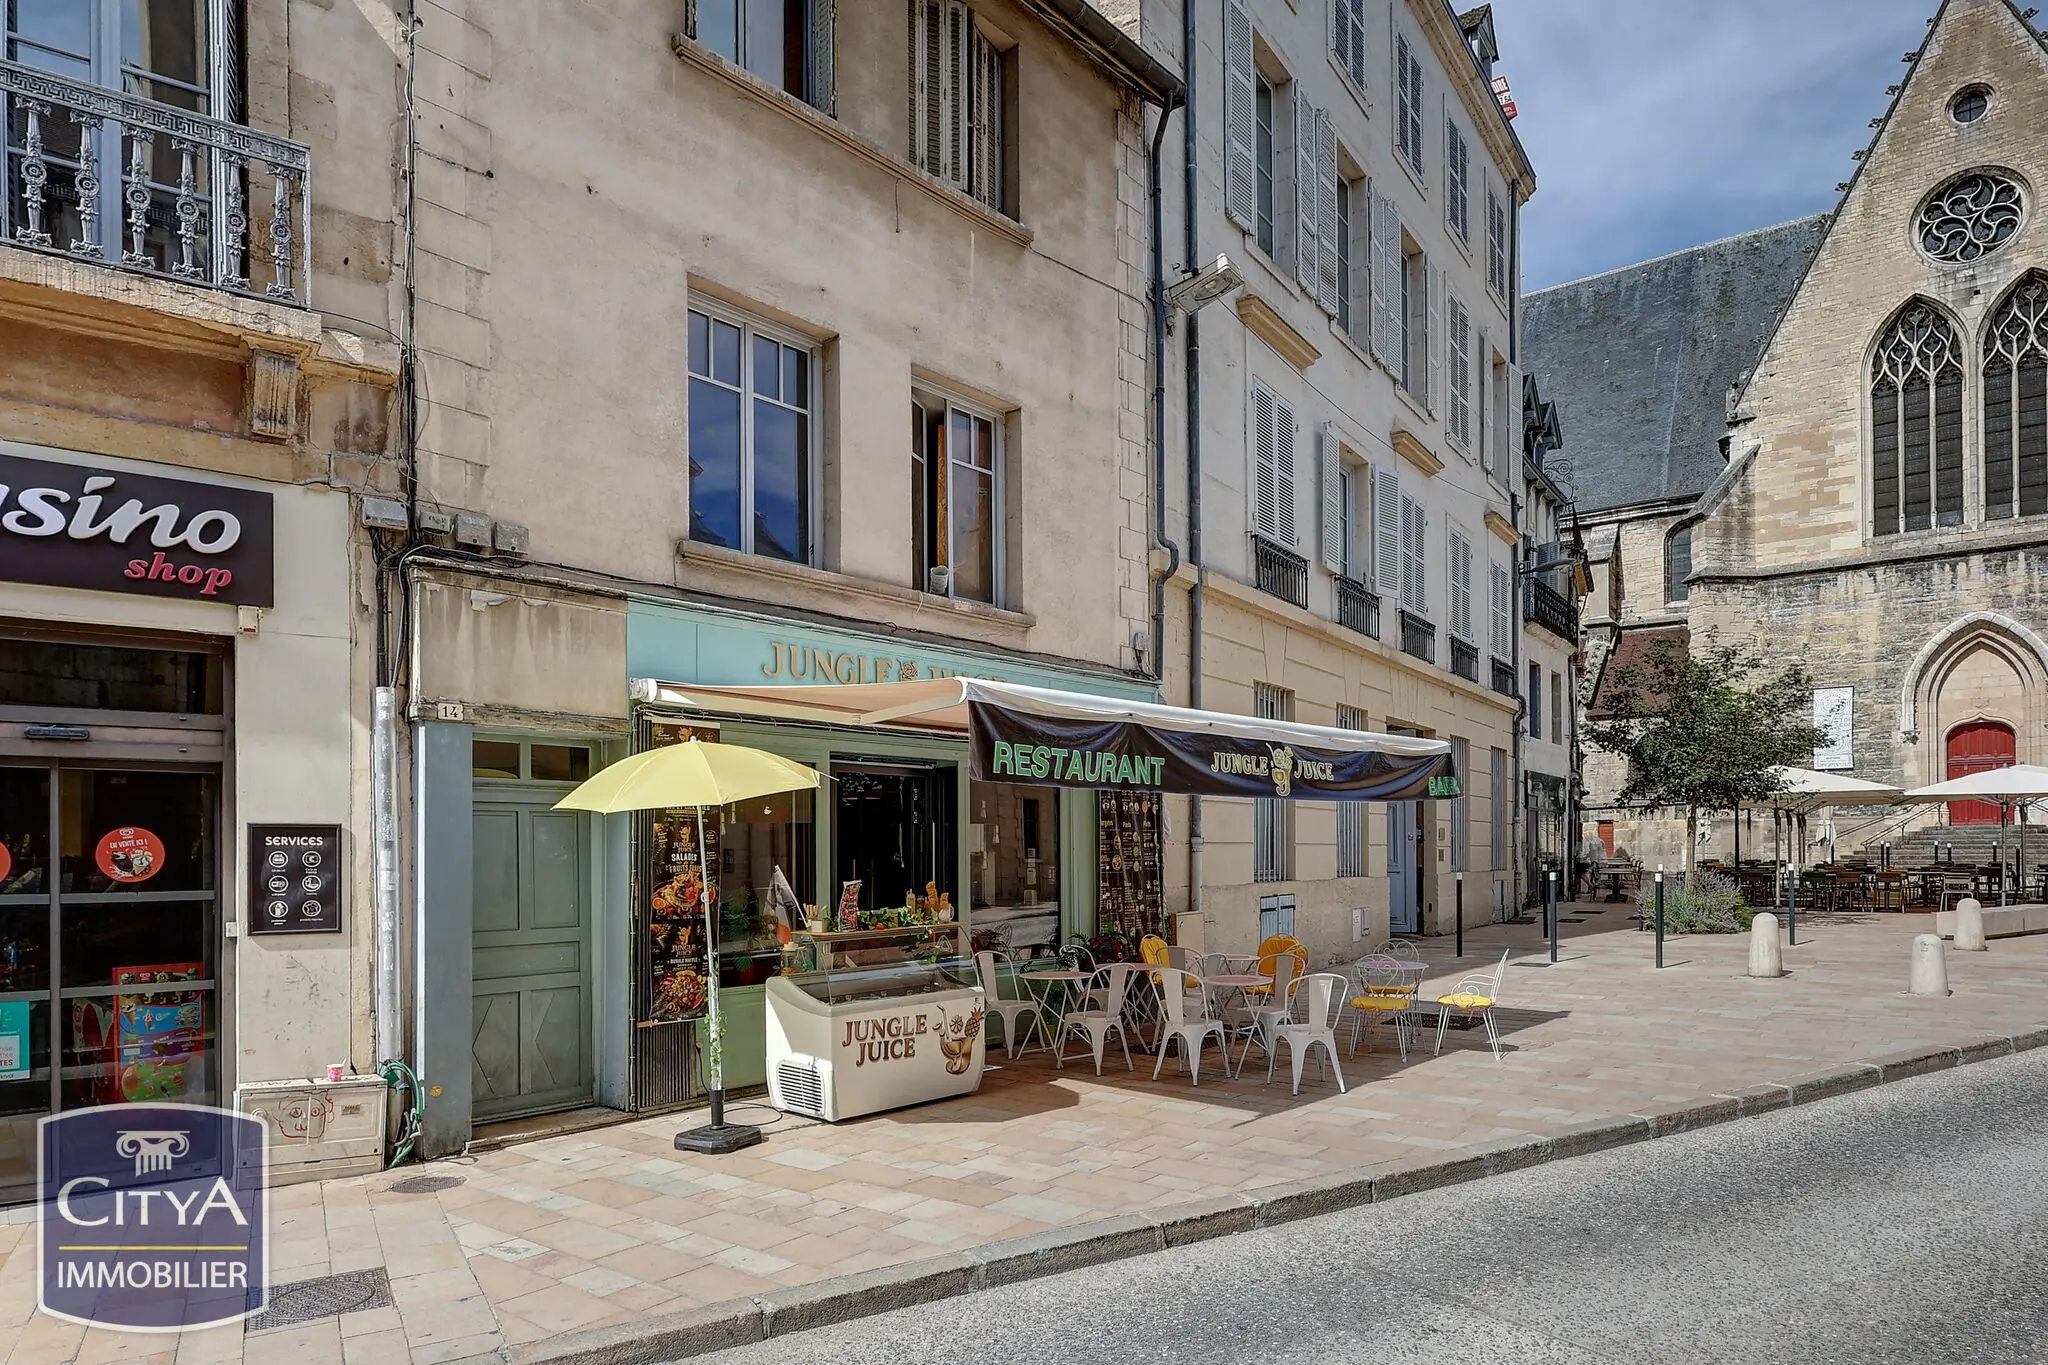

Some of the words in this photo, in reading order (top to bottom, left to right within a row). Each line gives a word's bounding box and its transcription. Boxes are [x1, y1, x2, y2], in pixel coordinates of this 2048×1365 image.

[0, 476, 241, 554] sino
[123, 552, 232, 595] shop
[762, 642, 894, 685] JUNGLE
[443, 706, 458, 718] 14
[993, 741, 1165, 785] RESTAURANT
[1211, 752, 1269, 776] JUNGLE
[1294, 759, 1334, 780] JUICE
[265, 836, 324, 846] SERVICES
[671, 853, 698, 862] SALADES
[842, 1014, 927, 1047] JUNGLE
[856, 1038, 916, 1067] JUICE
